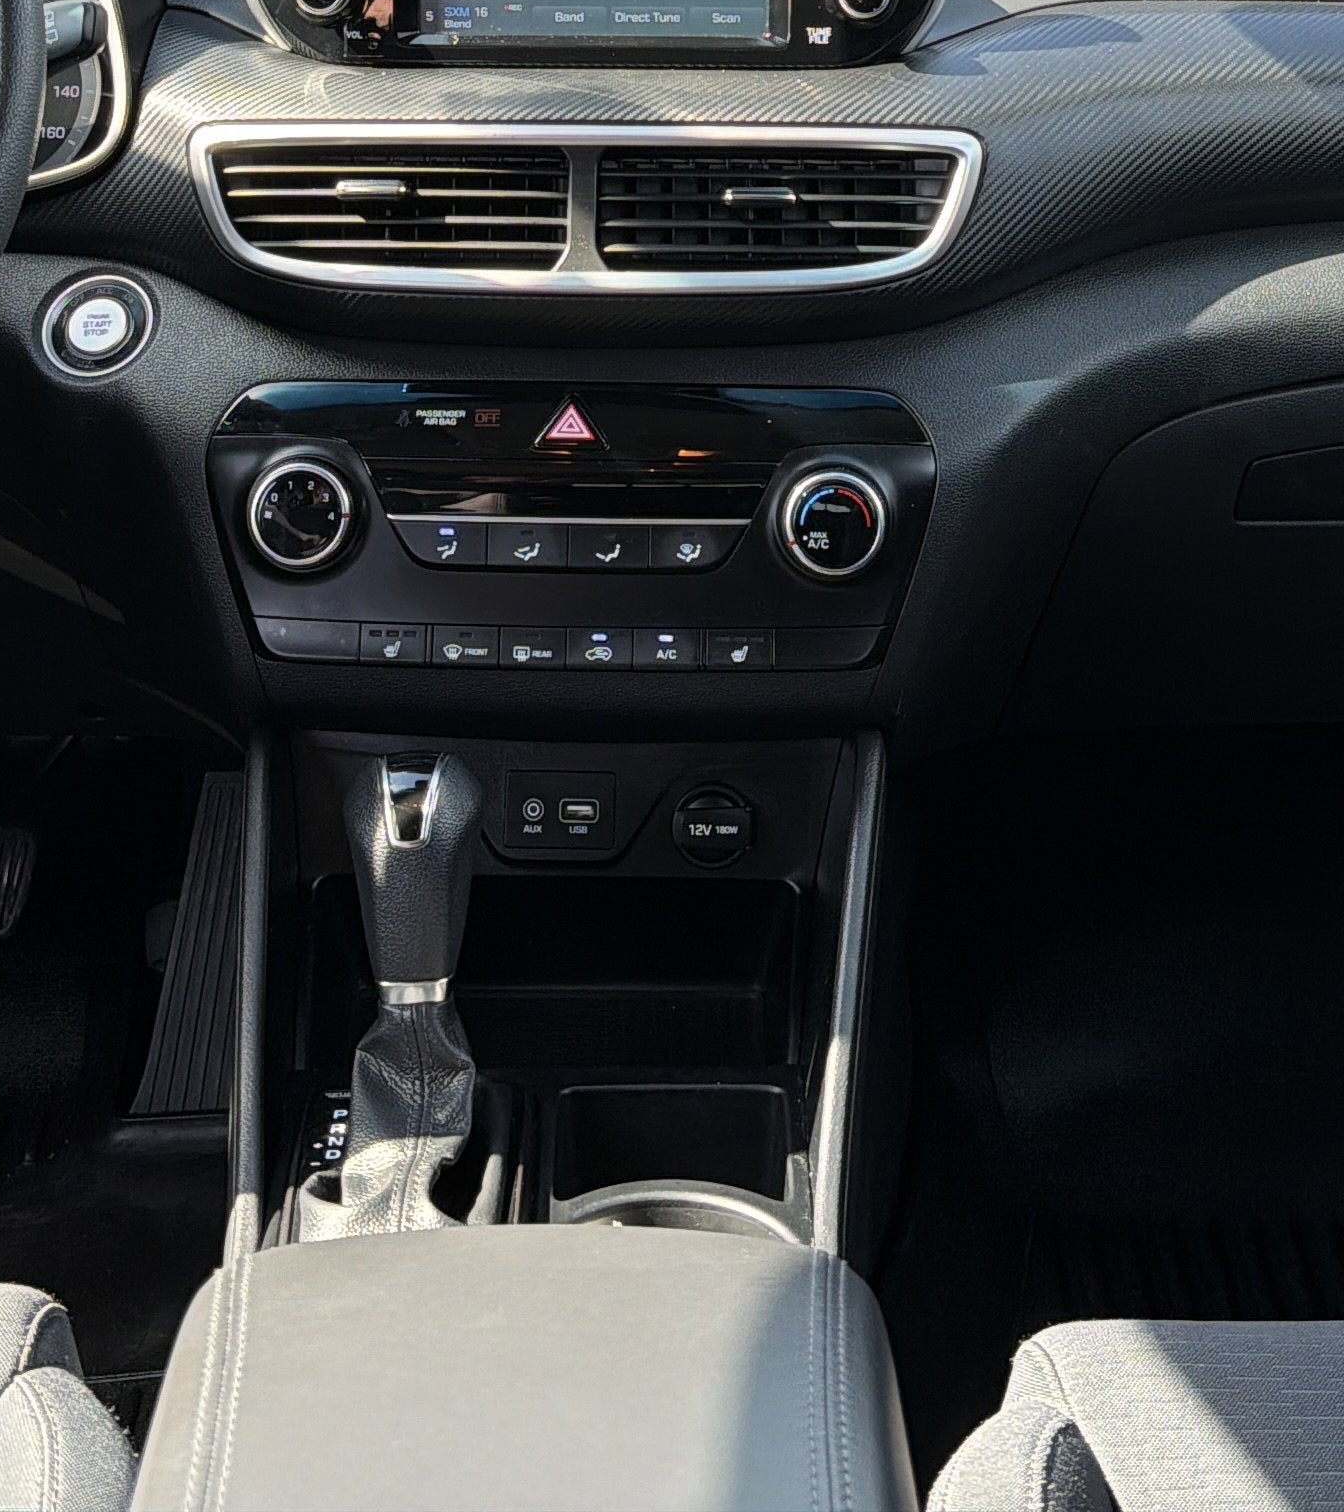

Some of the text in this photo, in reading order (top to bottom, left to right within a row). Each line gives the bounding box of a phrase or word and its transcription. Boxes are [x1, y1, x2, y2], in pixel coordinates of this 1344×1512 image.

[425, 11, 434, 22] 5
[444, 7, 489, 17] SXM 16
[555, 12, 585, 23] Band
[614, 12, 681, 23] Direct Tune
[444, 19, 472, 29] Blend
[712, 13, 741, 24] Scan
[346, 31, 363, 39] VOL
[806, 27, 832, 36] TUNE
[808, 35, 829, 44] FILE
[53, 85, 80, 98] 140
[40, 126, 66, 139] 160
[415, 410, 467, 418] PASSENGER
[475, 412, 501, 424] OFF
[287, 481, 293, 490] 1
[307, 480, 315, 490] 2
[322, 492, 330, 503] 3
[327, 511, 335, 521] 4
[809, 531, 828, 539] MAX
[807, 538, 830, 549] A/C
[464, 647, 489, 657] FRONT
[532, 649, 553, 659] REAR
[656, 649, 677, 660] A/C
[523, 824, 543, 834] AUX
[569, 825, 588, 834] USB
[689, 824, 712, 836] 12V
[333, 1109, 348, 1120] P
[329, 1123, 347, 1134] R
[328, 1136, 344, 1147] N
[325, 1149, 342, 1160] D
